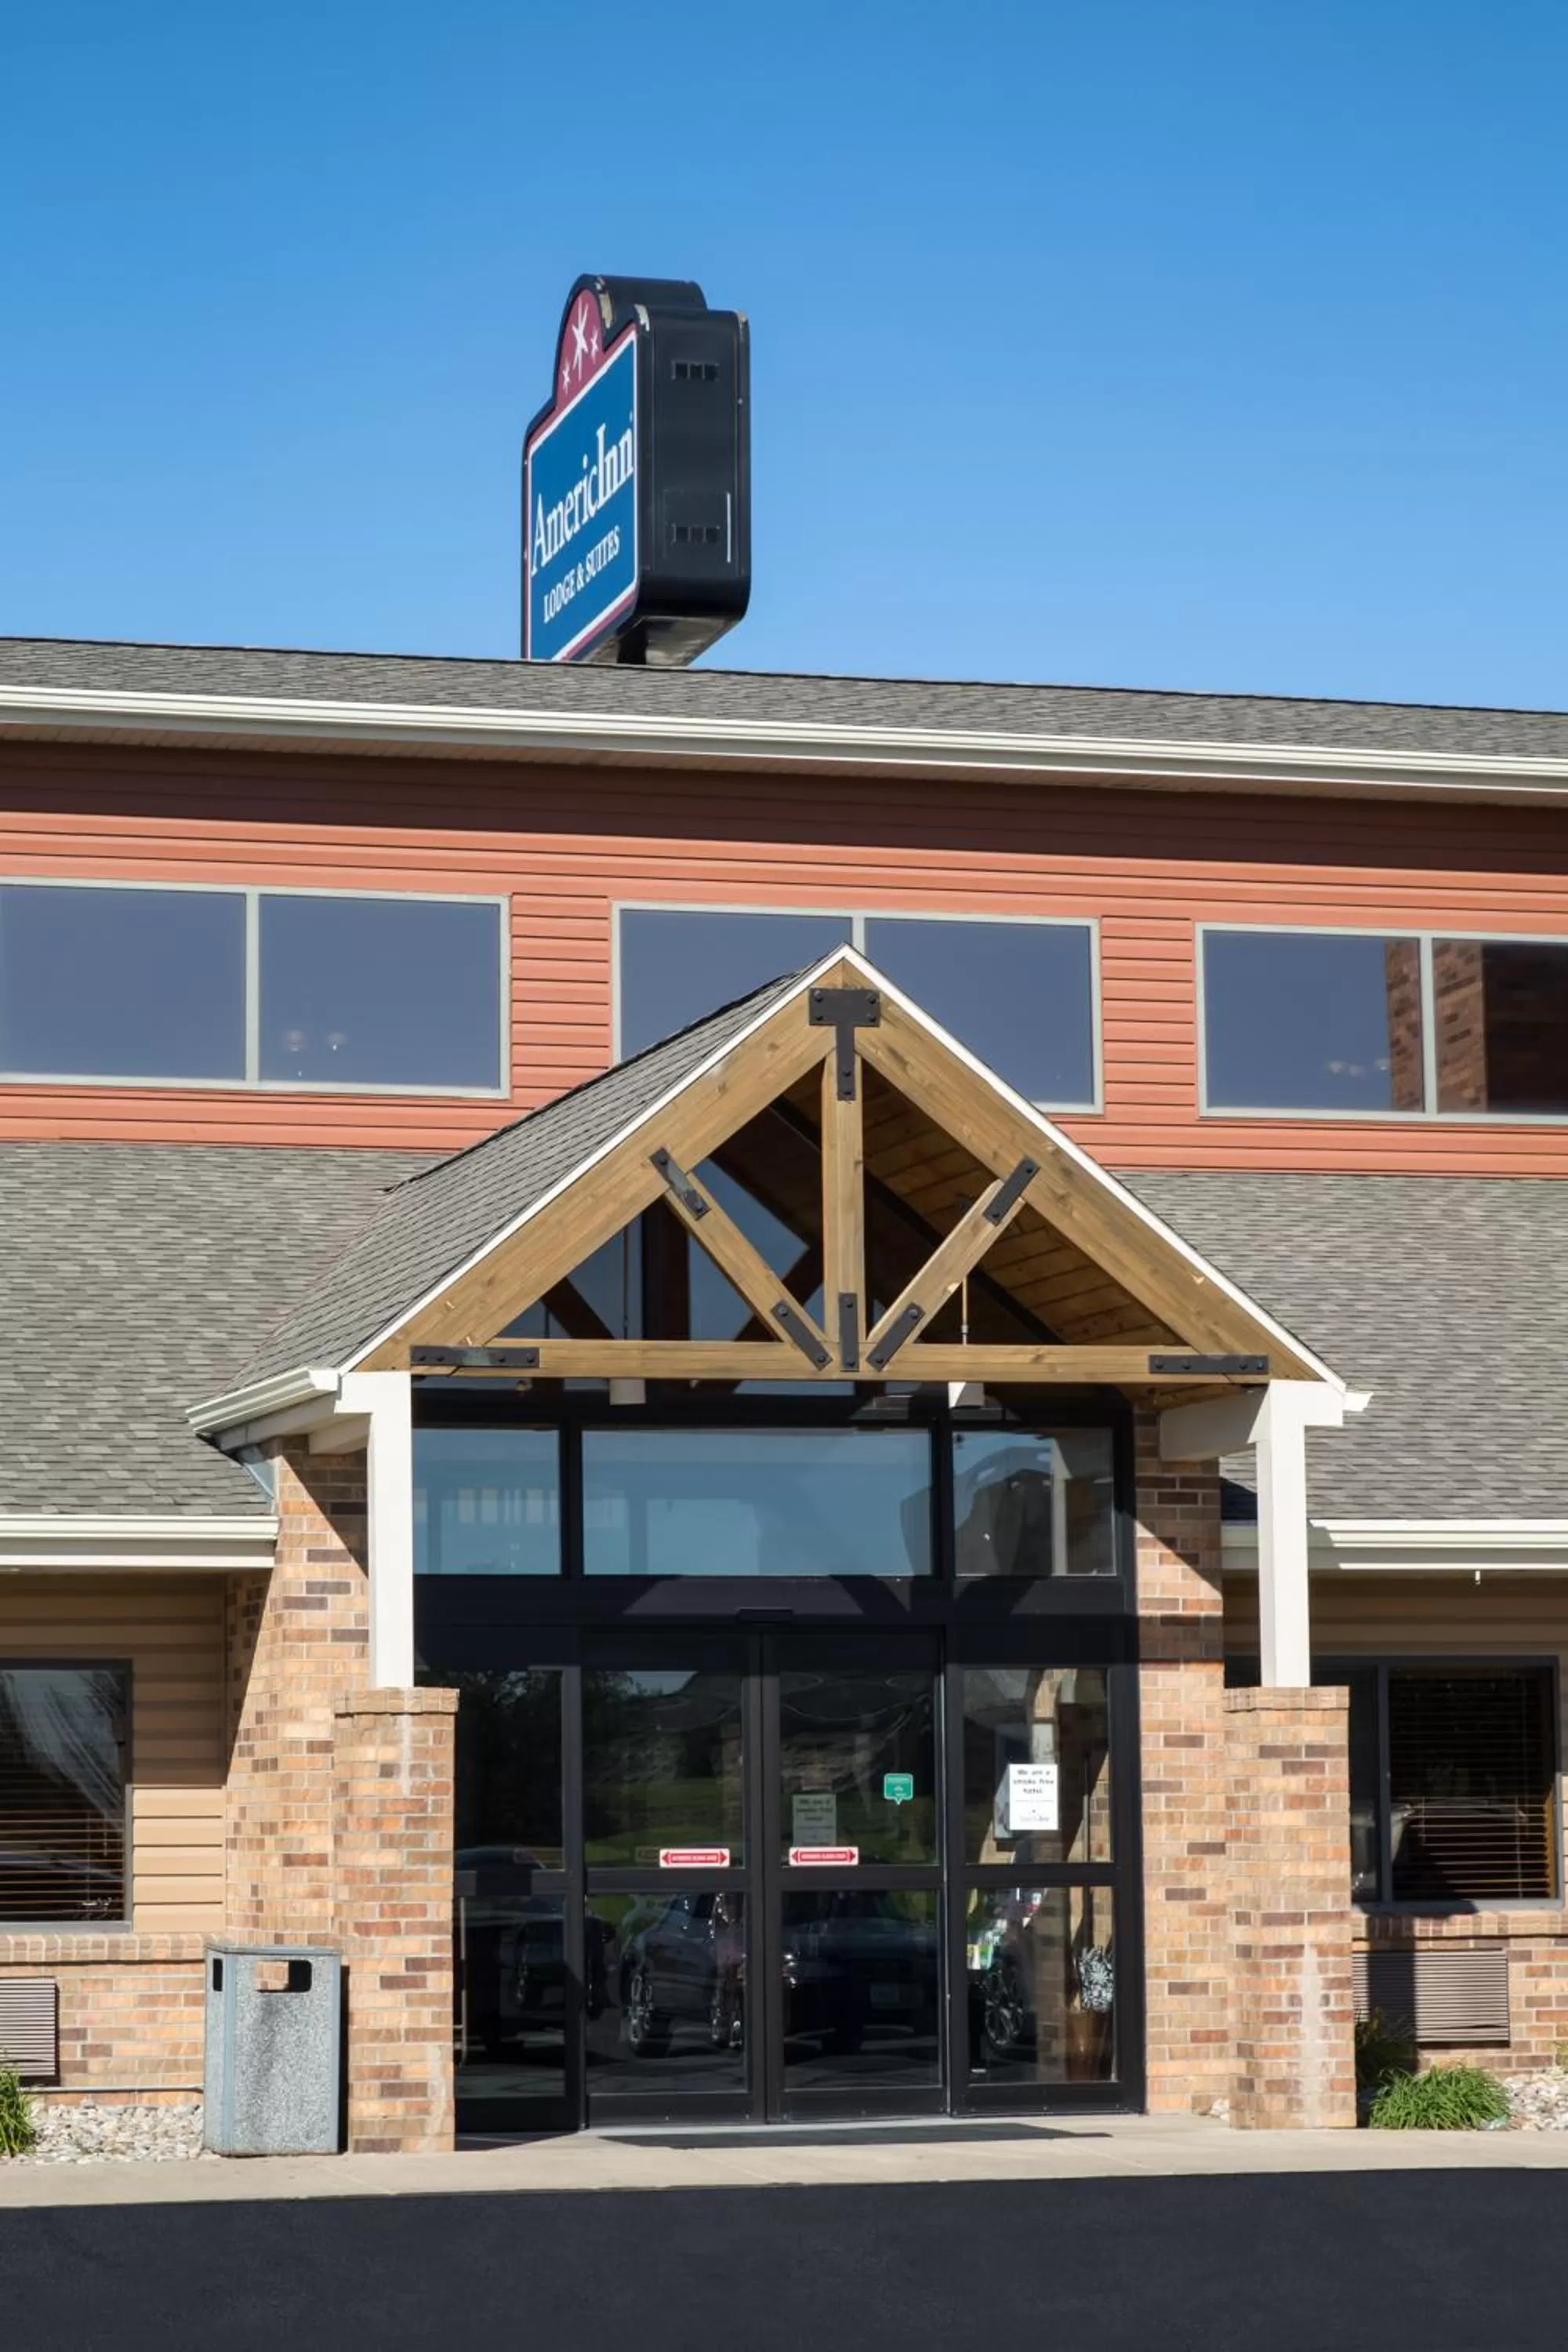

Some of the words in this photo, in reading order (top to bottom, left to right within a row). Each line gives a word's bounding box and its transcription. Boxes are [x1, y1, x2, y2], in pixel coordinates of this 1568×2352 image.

[531, 422, 633, 577] AmericInn
[543, 568, 575, 624] LODGE
[576, 562, 585, 592] &
[585, 524, 620, 583] SUITES
